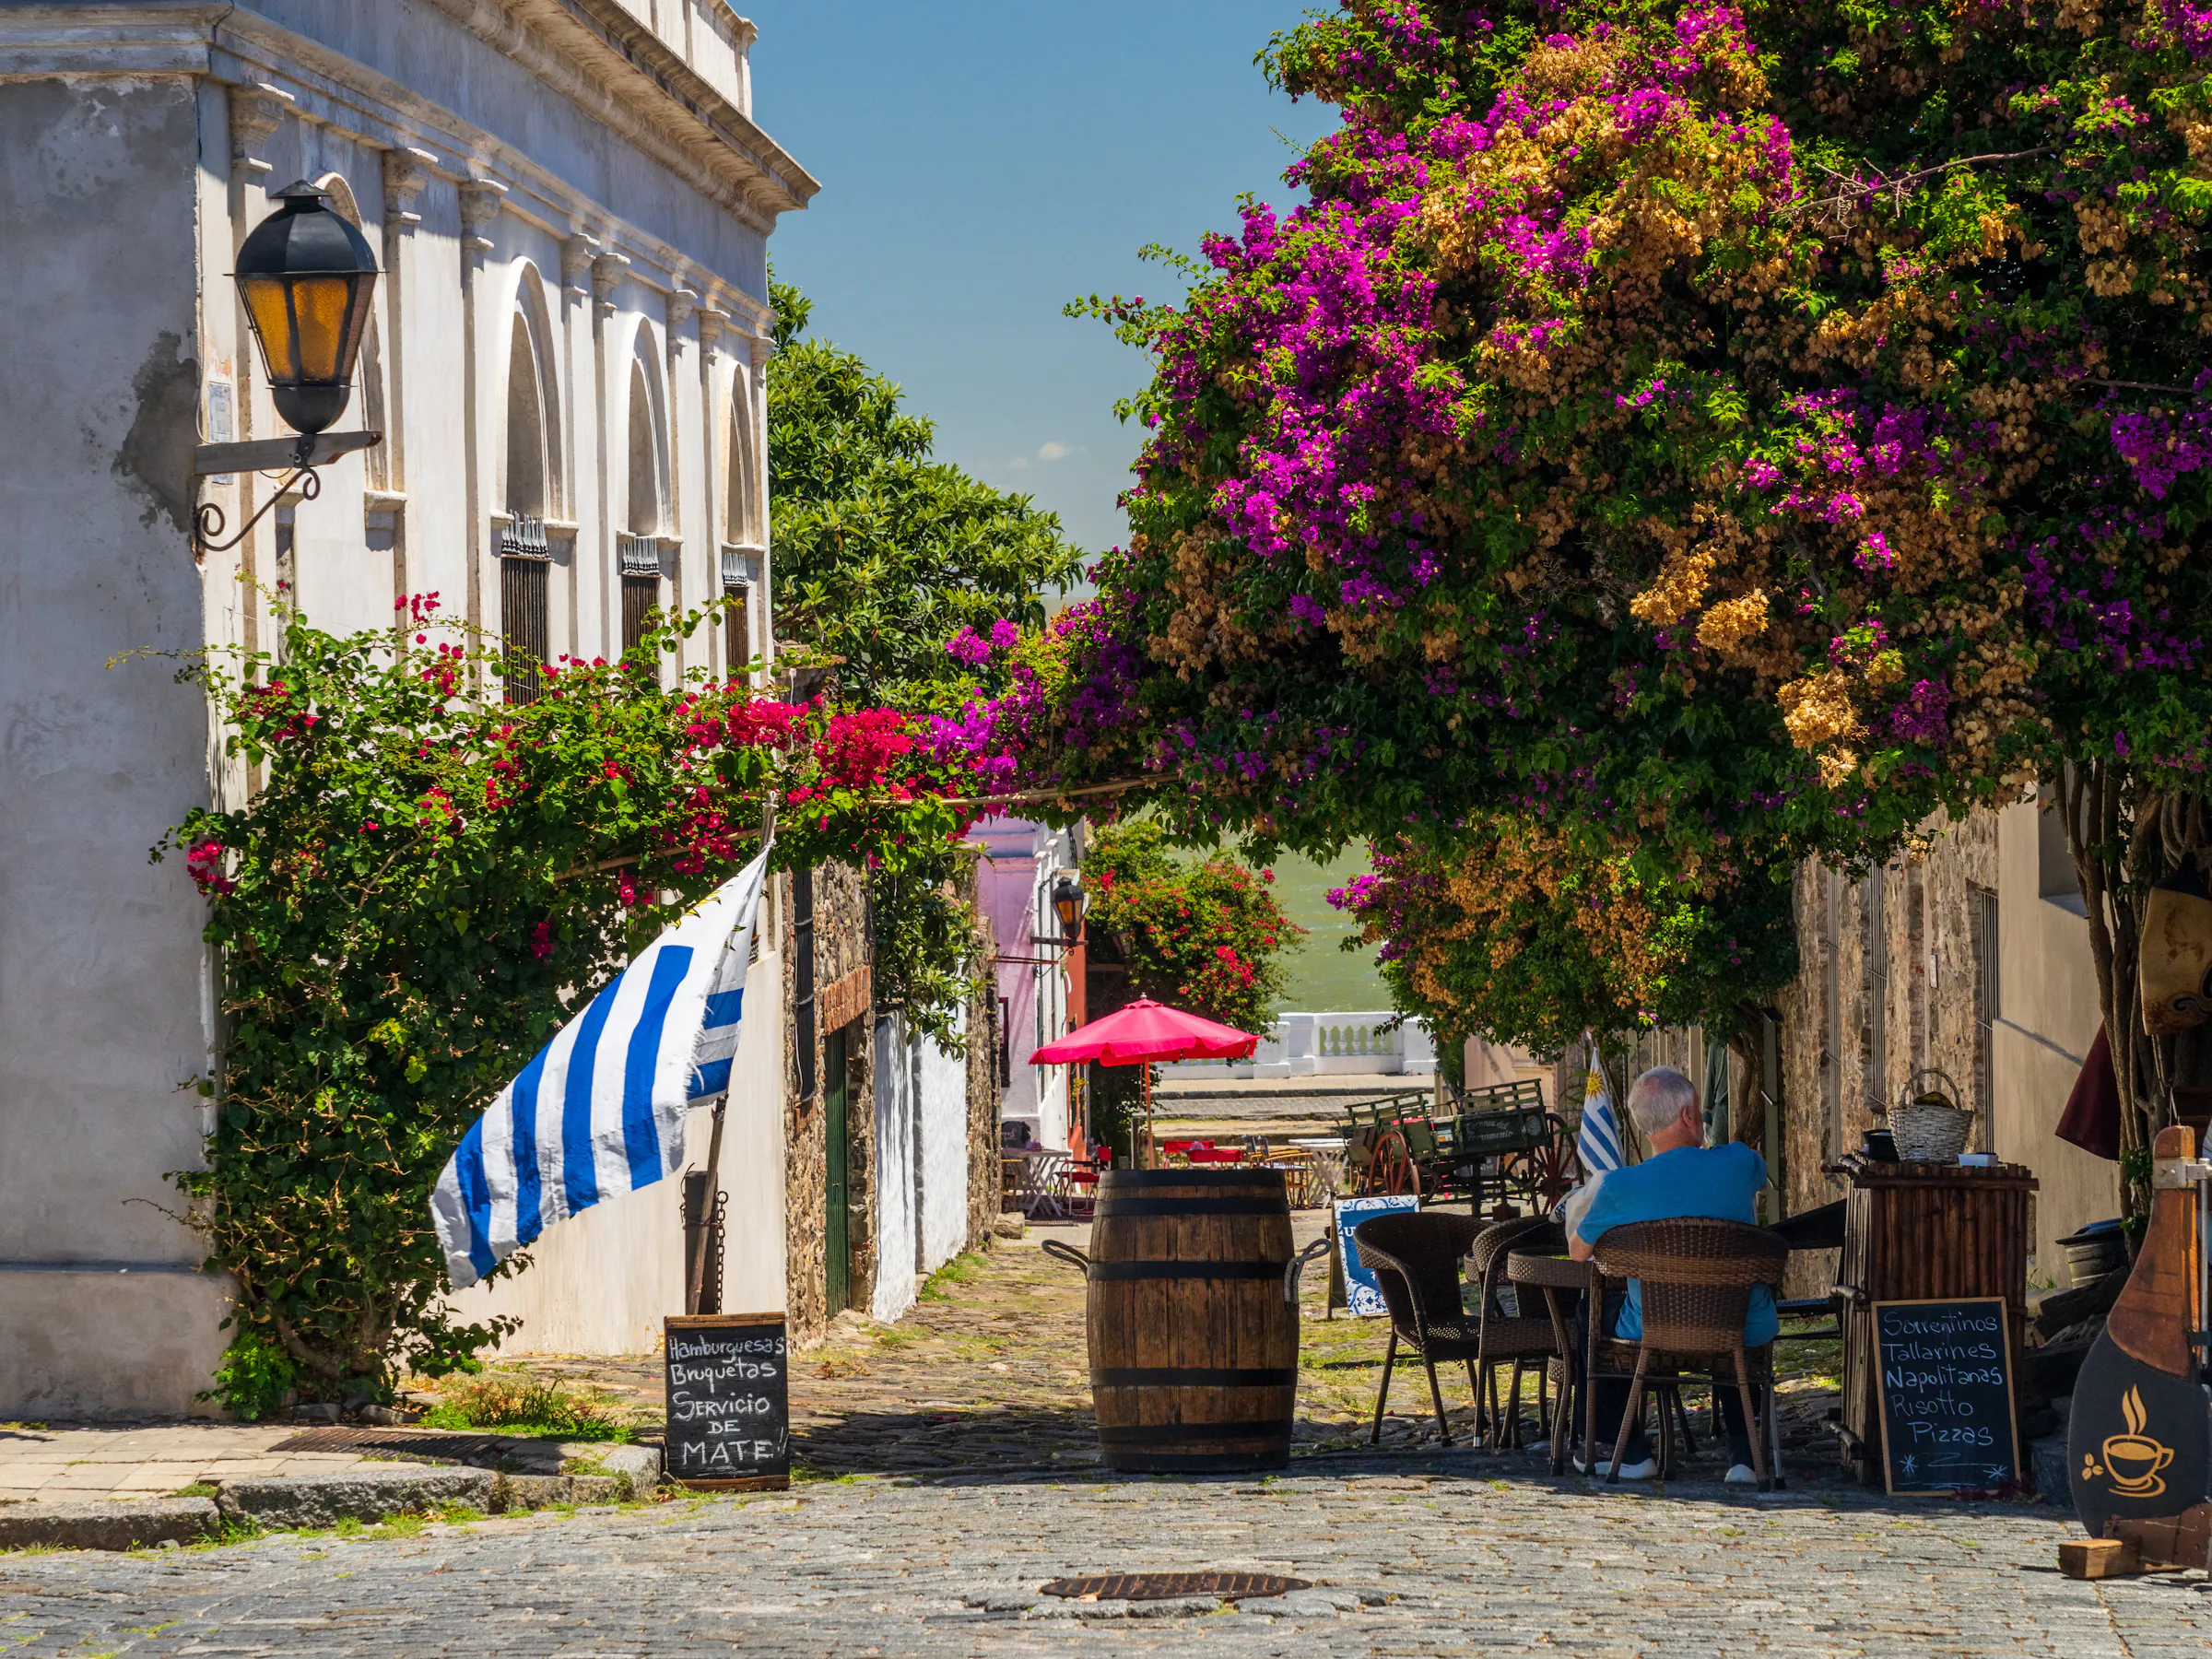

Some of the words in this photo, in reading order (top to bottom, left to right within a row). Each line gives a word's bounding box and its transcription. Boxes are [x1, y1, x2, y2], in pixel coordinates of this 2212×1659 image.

[1884, 1310, 1998, 1336] Sorrentinos
[669, 1334, 785, 1364] Hamburguesas
[1881, 1341, 1996, 1362] Tallarines
[670, 1357, 777, 1394] Bruquetas
[1887, 1364, 2003, 1394] Napolitanas
[1890, 1390, 1973, 1417] Risotto
[707, 1419, 741, 1434] DE
[1907, 1421, 1994, 1446] Pizzas
